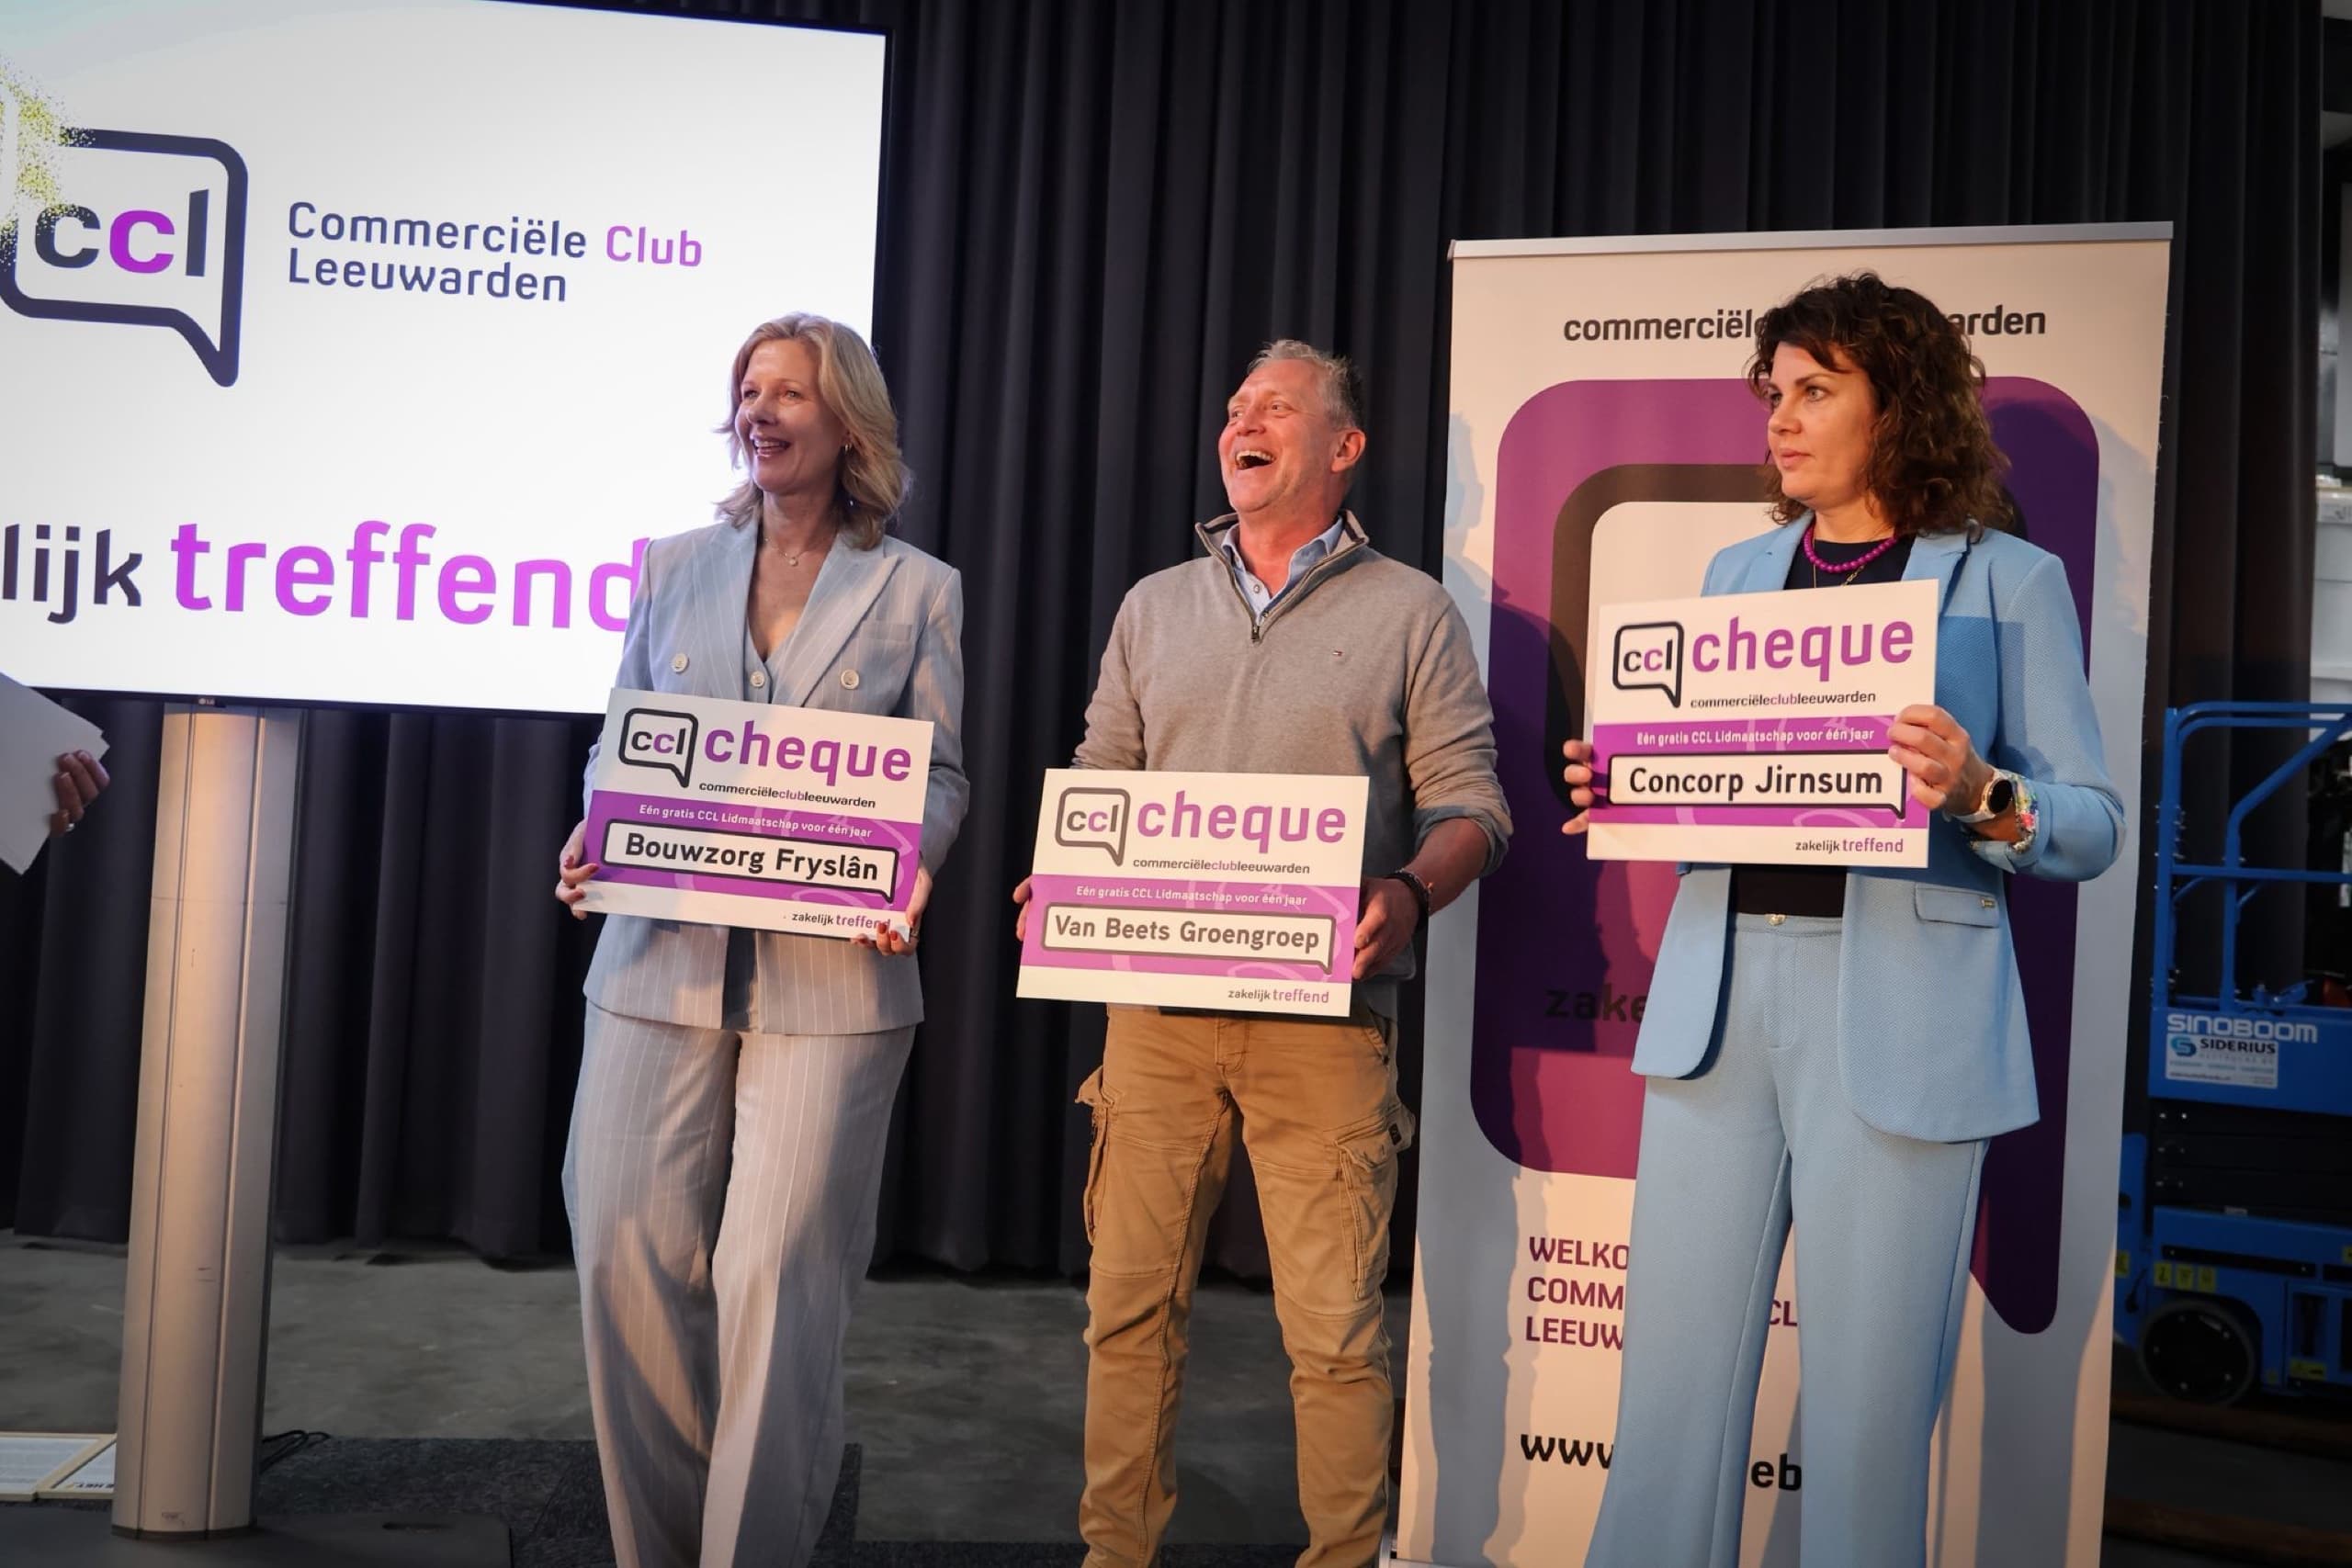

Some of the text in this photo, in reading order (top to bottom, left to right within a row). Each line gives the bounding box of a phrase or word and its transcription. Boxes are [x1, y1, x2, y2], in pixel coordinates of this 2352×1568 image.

[35, 189, 209, 276] ccl
[288, 201, 702, 266] Commerciële Club
[288, 247, 567, 301] Leeuwarden
[171, 520, 650, 632] treffend
[1623, 616, 1913, 682] ccl cheque
[1690, 691, 1875, 708] commerciëleclubleeuwarden
[1691, 731, 1712, 743] CCL
[1715, 729, 1793, 744] Lidmaatschap
[1797, 731, 1822, 740] voor
[1849, 728, 1874, 741] jaar
[631, 720, 911, 786] ccl cheque
[699, 782, 876, 809] commerciëleclubleeuwarden
[1630, 764, 1883, 801] Concorp Jirnsum
[662, 808, 695, 819] gratis
[697, 810, 718, 821] CCL
[722, 814, 797, 831] Lidmaatschap
[801, 823, 825, 831] voor
[850, 827, 872, 838] jaar
[1067, 791, 1345, 853] ccl cheque
[626, 833, 877, 880] Bouwzorg Fryslân
[1795, 838, 1903, 852] zakelijk treffend
[1133, 858, 1309, 874] commerciëleclubleeuwarden
[1098, 888, 1129, 898] gratis
[1132, 888, 1153, 898] CCL
[1156, 889, 1232, 904] Lidmaatschap
[1235, 893, 1259, 903] voor
[1284, 895, 1306, 906] jaar
[792, 912, 833, 925] zakelijk
[1056, 915, 1318, 953] Van Beets Groengroep
[1228, 988, 1329, 1003] zakelijk treffend
[2200, 1039, 2276, 1055] SIDERIUS
[1529, 1236, 1629, 1269] WELKO
[1527, 1277, 1623, 1310] COMM
[1526, 1316, 1623, 1350] LEEUW
